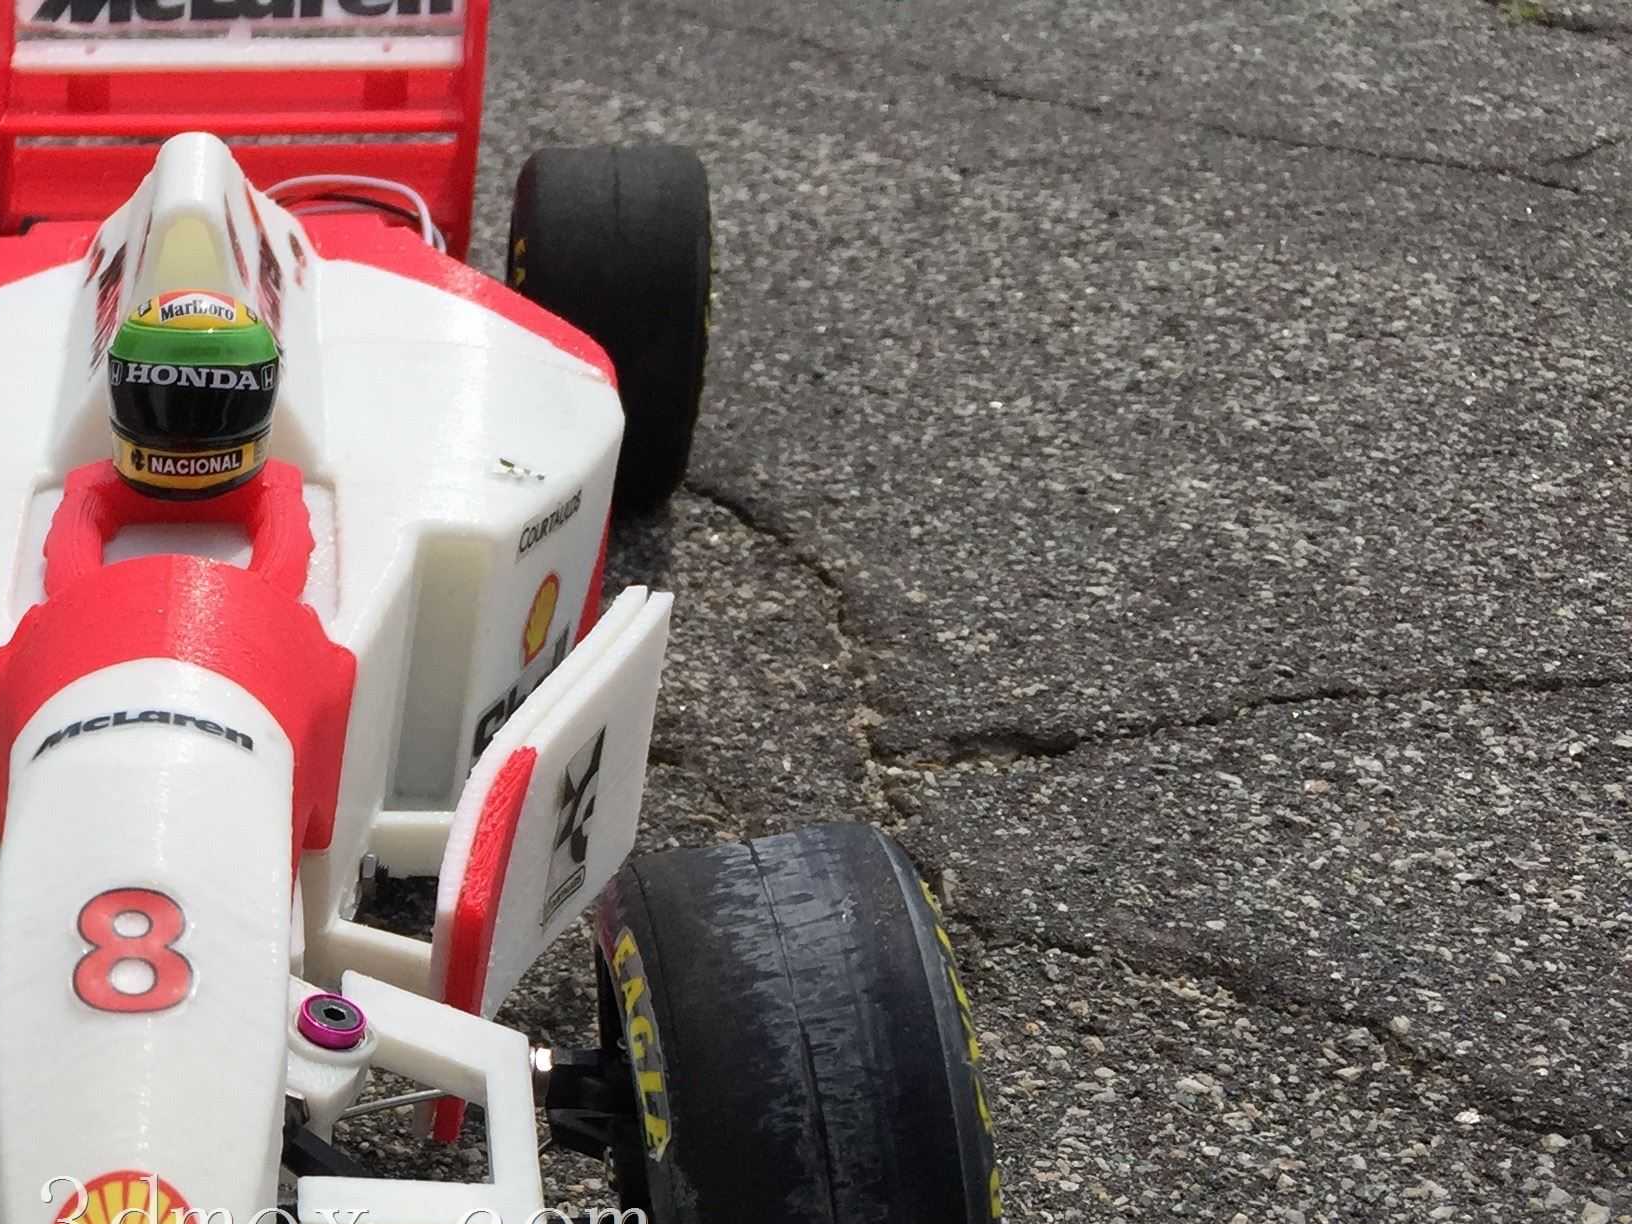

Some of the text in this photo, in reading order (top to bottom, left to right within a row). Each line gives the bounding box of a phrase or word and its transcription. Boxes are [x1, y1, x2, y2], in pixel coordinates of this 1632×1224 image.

[125, 362, 260, 391] HONDA
[150, 452, 241, 475] NACIONAL
[31, 709, 255, 762] McLaren
[72, 886, 195, 1015] 8
